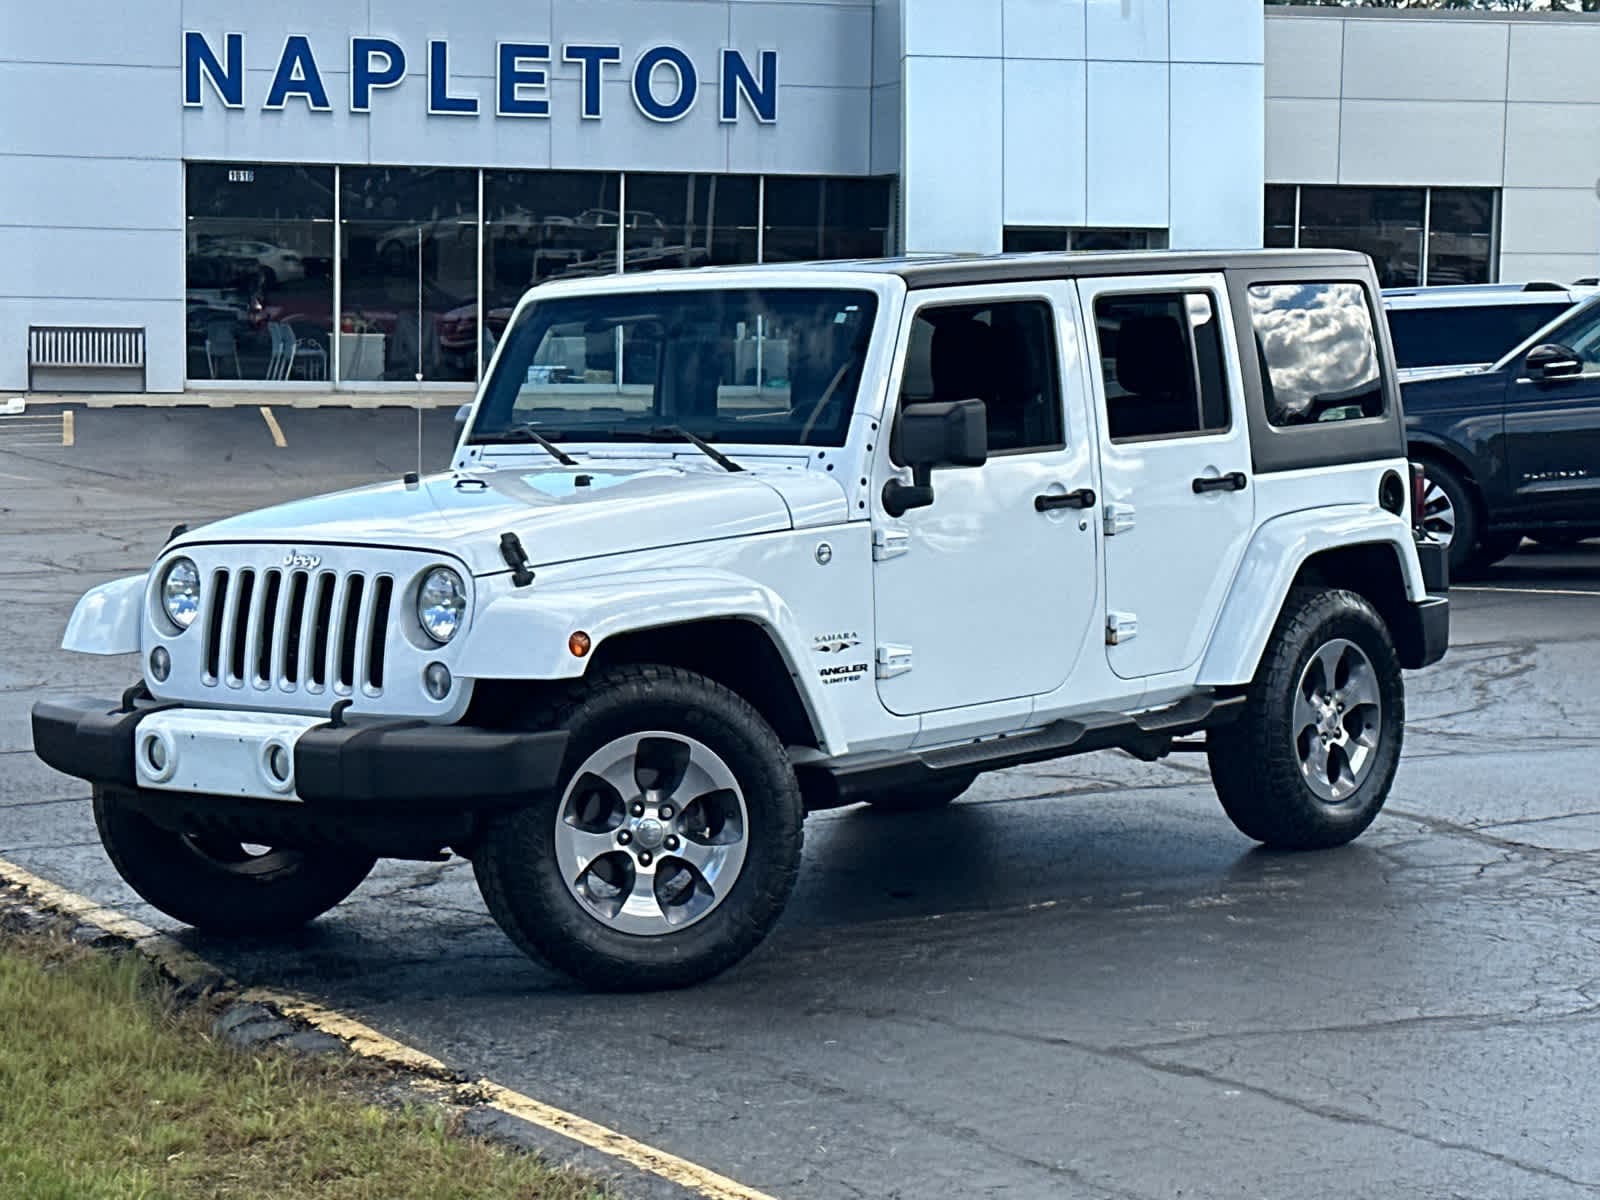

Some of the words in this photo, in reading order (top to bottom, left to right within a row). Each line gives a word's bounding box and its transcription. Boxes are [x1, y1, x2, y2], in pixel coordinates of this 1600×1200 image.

[182, 29, 777, 124] NAPLETON
[283, 549, 321, 570] Jeep
[814, 632, 858, 641] SAHARA
[819, 663, 868, 676] ANGLER
[822, 674, 861, 685] LIMITED
